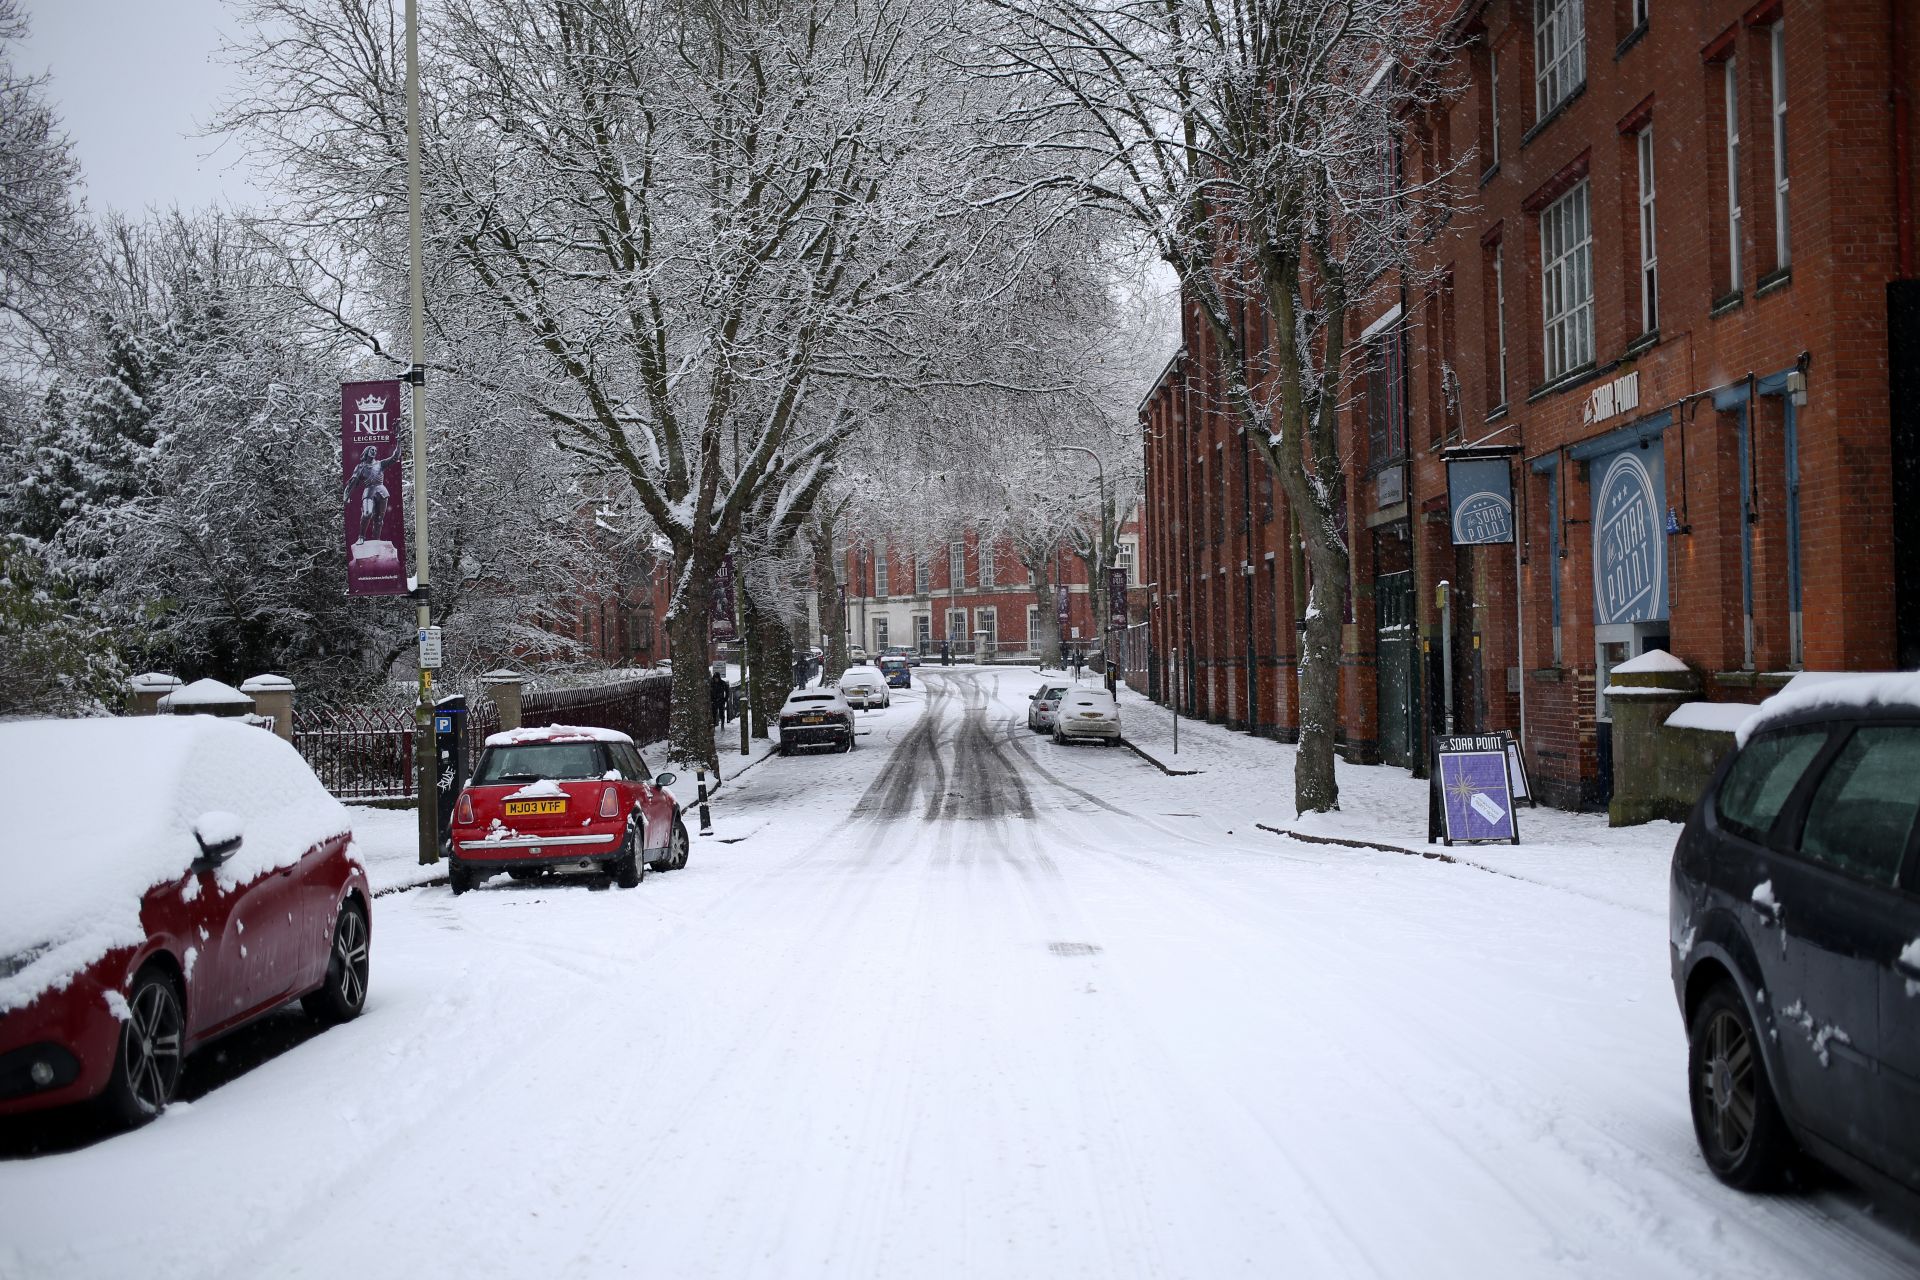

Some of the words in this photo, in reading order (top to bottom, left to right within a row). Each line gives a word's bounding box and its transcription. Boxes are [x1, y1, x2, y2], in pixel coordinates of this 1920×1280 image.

[1592, 382, 1615, 423] SOAR
[1614, 371, 1639, 414] POINT
[353, 434, 390, 443] LEICESTER
[1476, 506, 1504, 525] SOAR
[1468, 519, 1506, 541] POINT
[1616, 499, 1646, 561] SOAR
[1608, 541, 1649, 614] POINT
[439, 719, 449, 730] P
[1449, 737, 1474, 751] SOAR
[1475, 736, 1502, 750] POINT
[510, 802, 538, 813] MJ03
[540, 801, 561, 812] VTF
